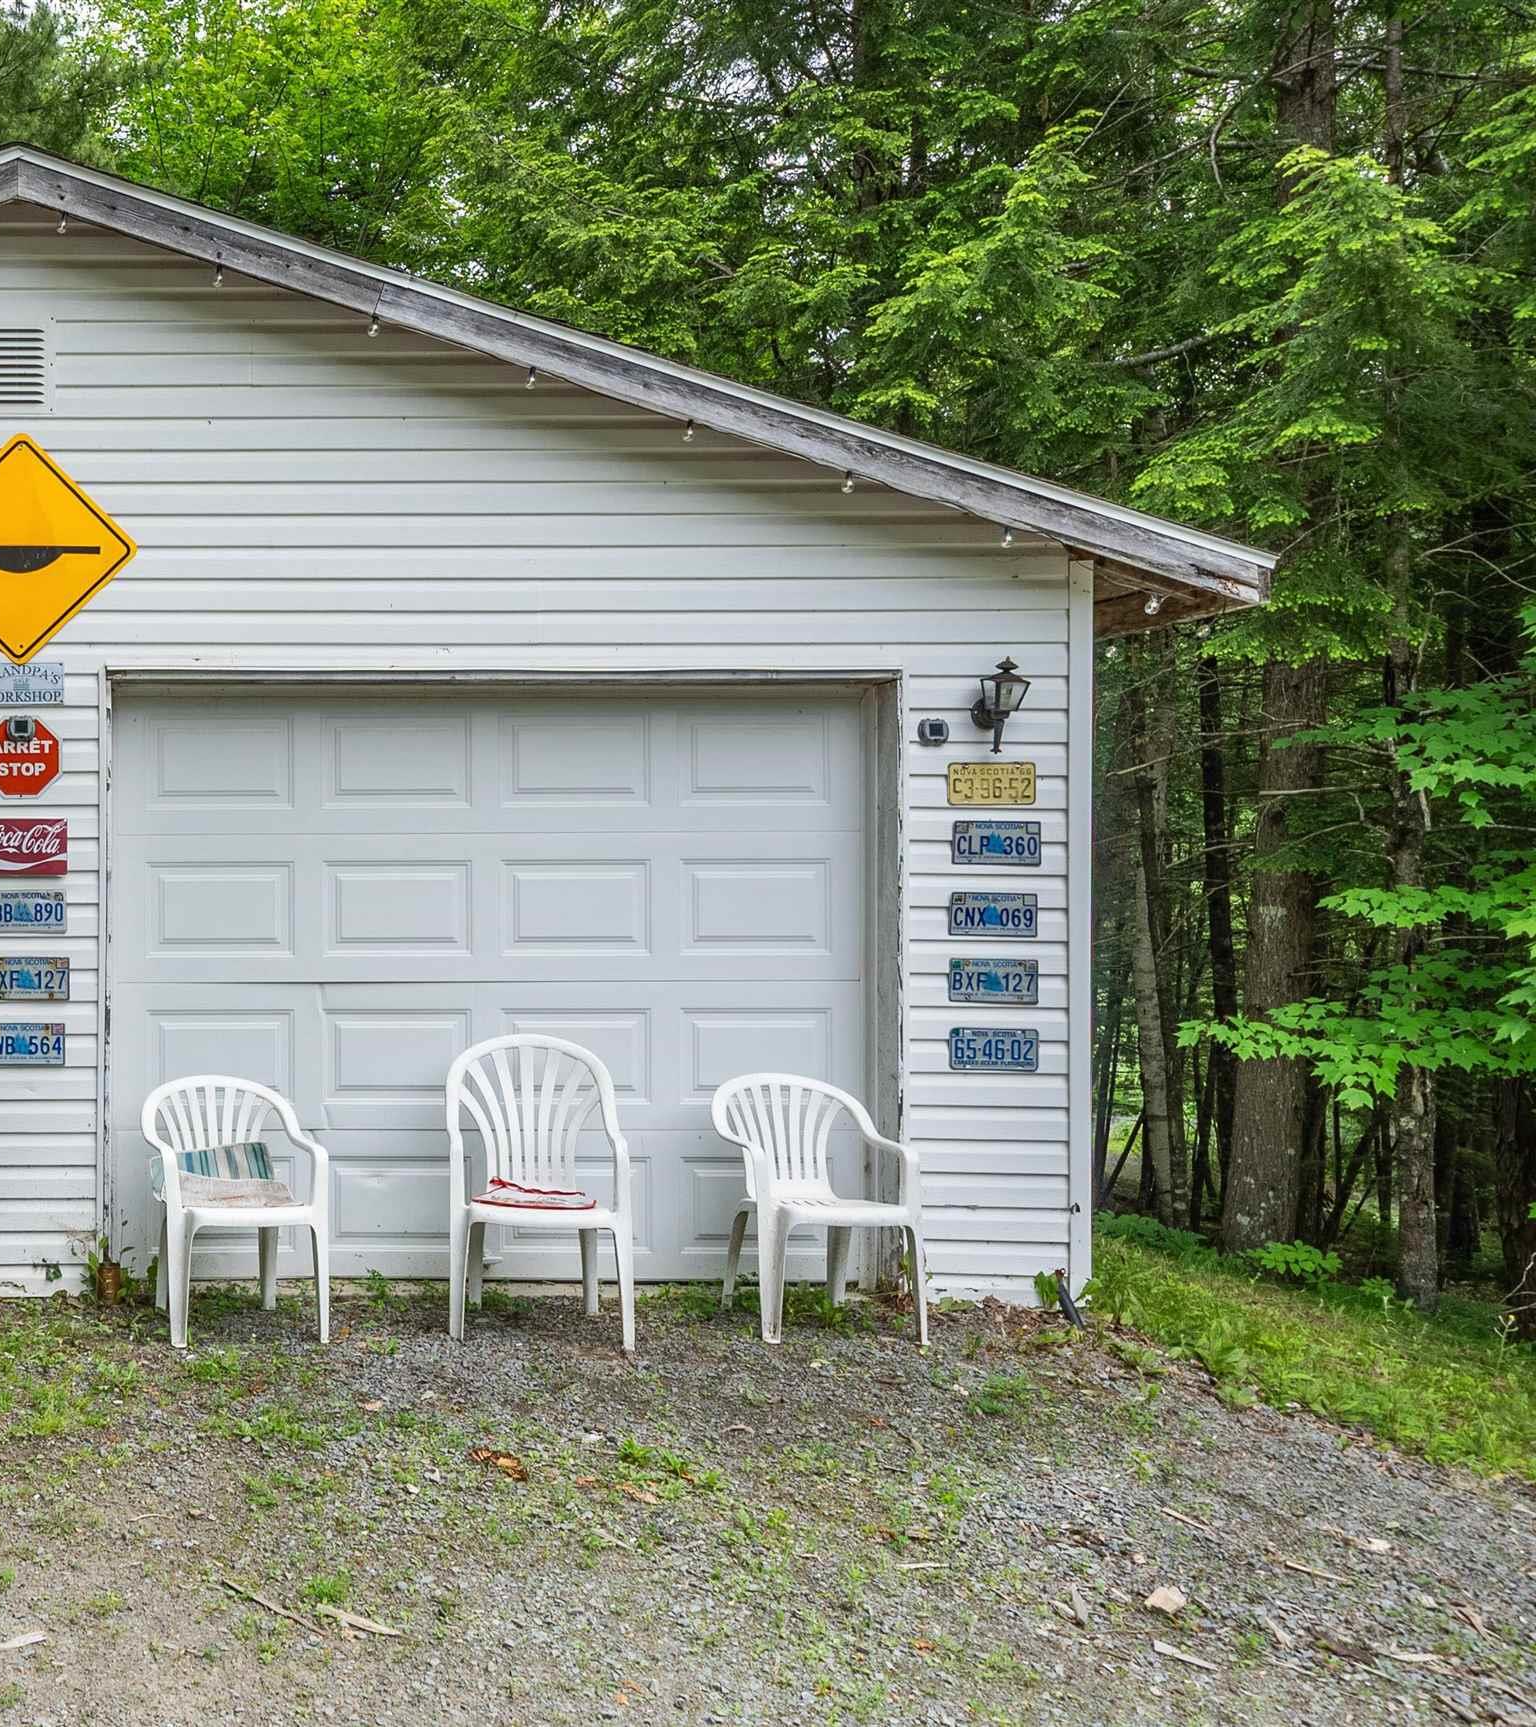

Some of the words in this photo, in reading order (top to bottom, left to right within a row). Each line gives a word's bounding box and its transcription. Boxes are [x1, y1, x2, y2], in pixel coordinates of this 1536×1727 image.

[957, 835, 991, 855] CLP
[1003, 836, 1038, 856] 360
[34, 902, 64, 922] 890
[954, 907, 986, 926] CNX
[1000, 908, 1033, 928] 069
[34, 970, 66, 989] 127
[952, 972, 987, 991] BXF
[1002, 973, 1034, 992] 127
[28, 1036, 62, 1055] 564
